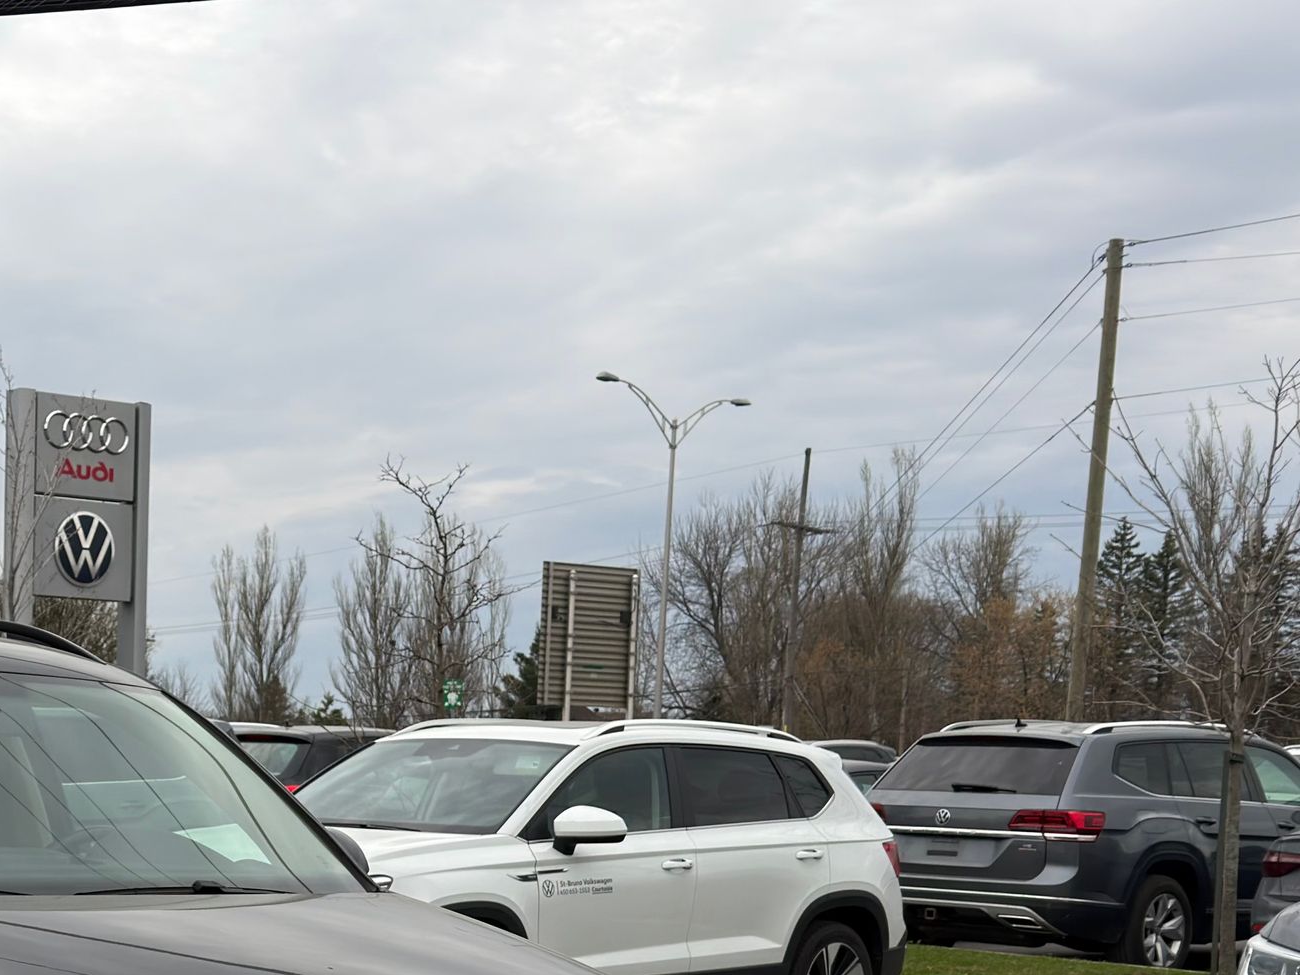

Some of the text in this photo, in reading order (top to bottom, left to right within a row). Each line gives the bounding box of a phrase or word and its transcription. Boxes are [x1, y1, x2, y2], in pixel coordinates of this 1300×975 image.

[55, 458, 114, 482] Audi
[55, 511, 115, 587] VW
[542, 880, 555, 897] VW
